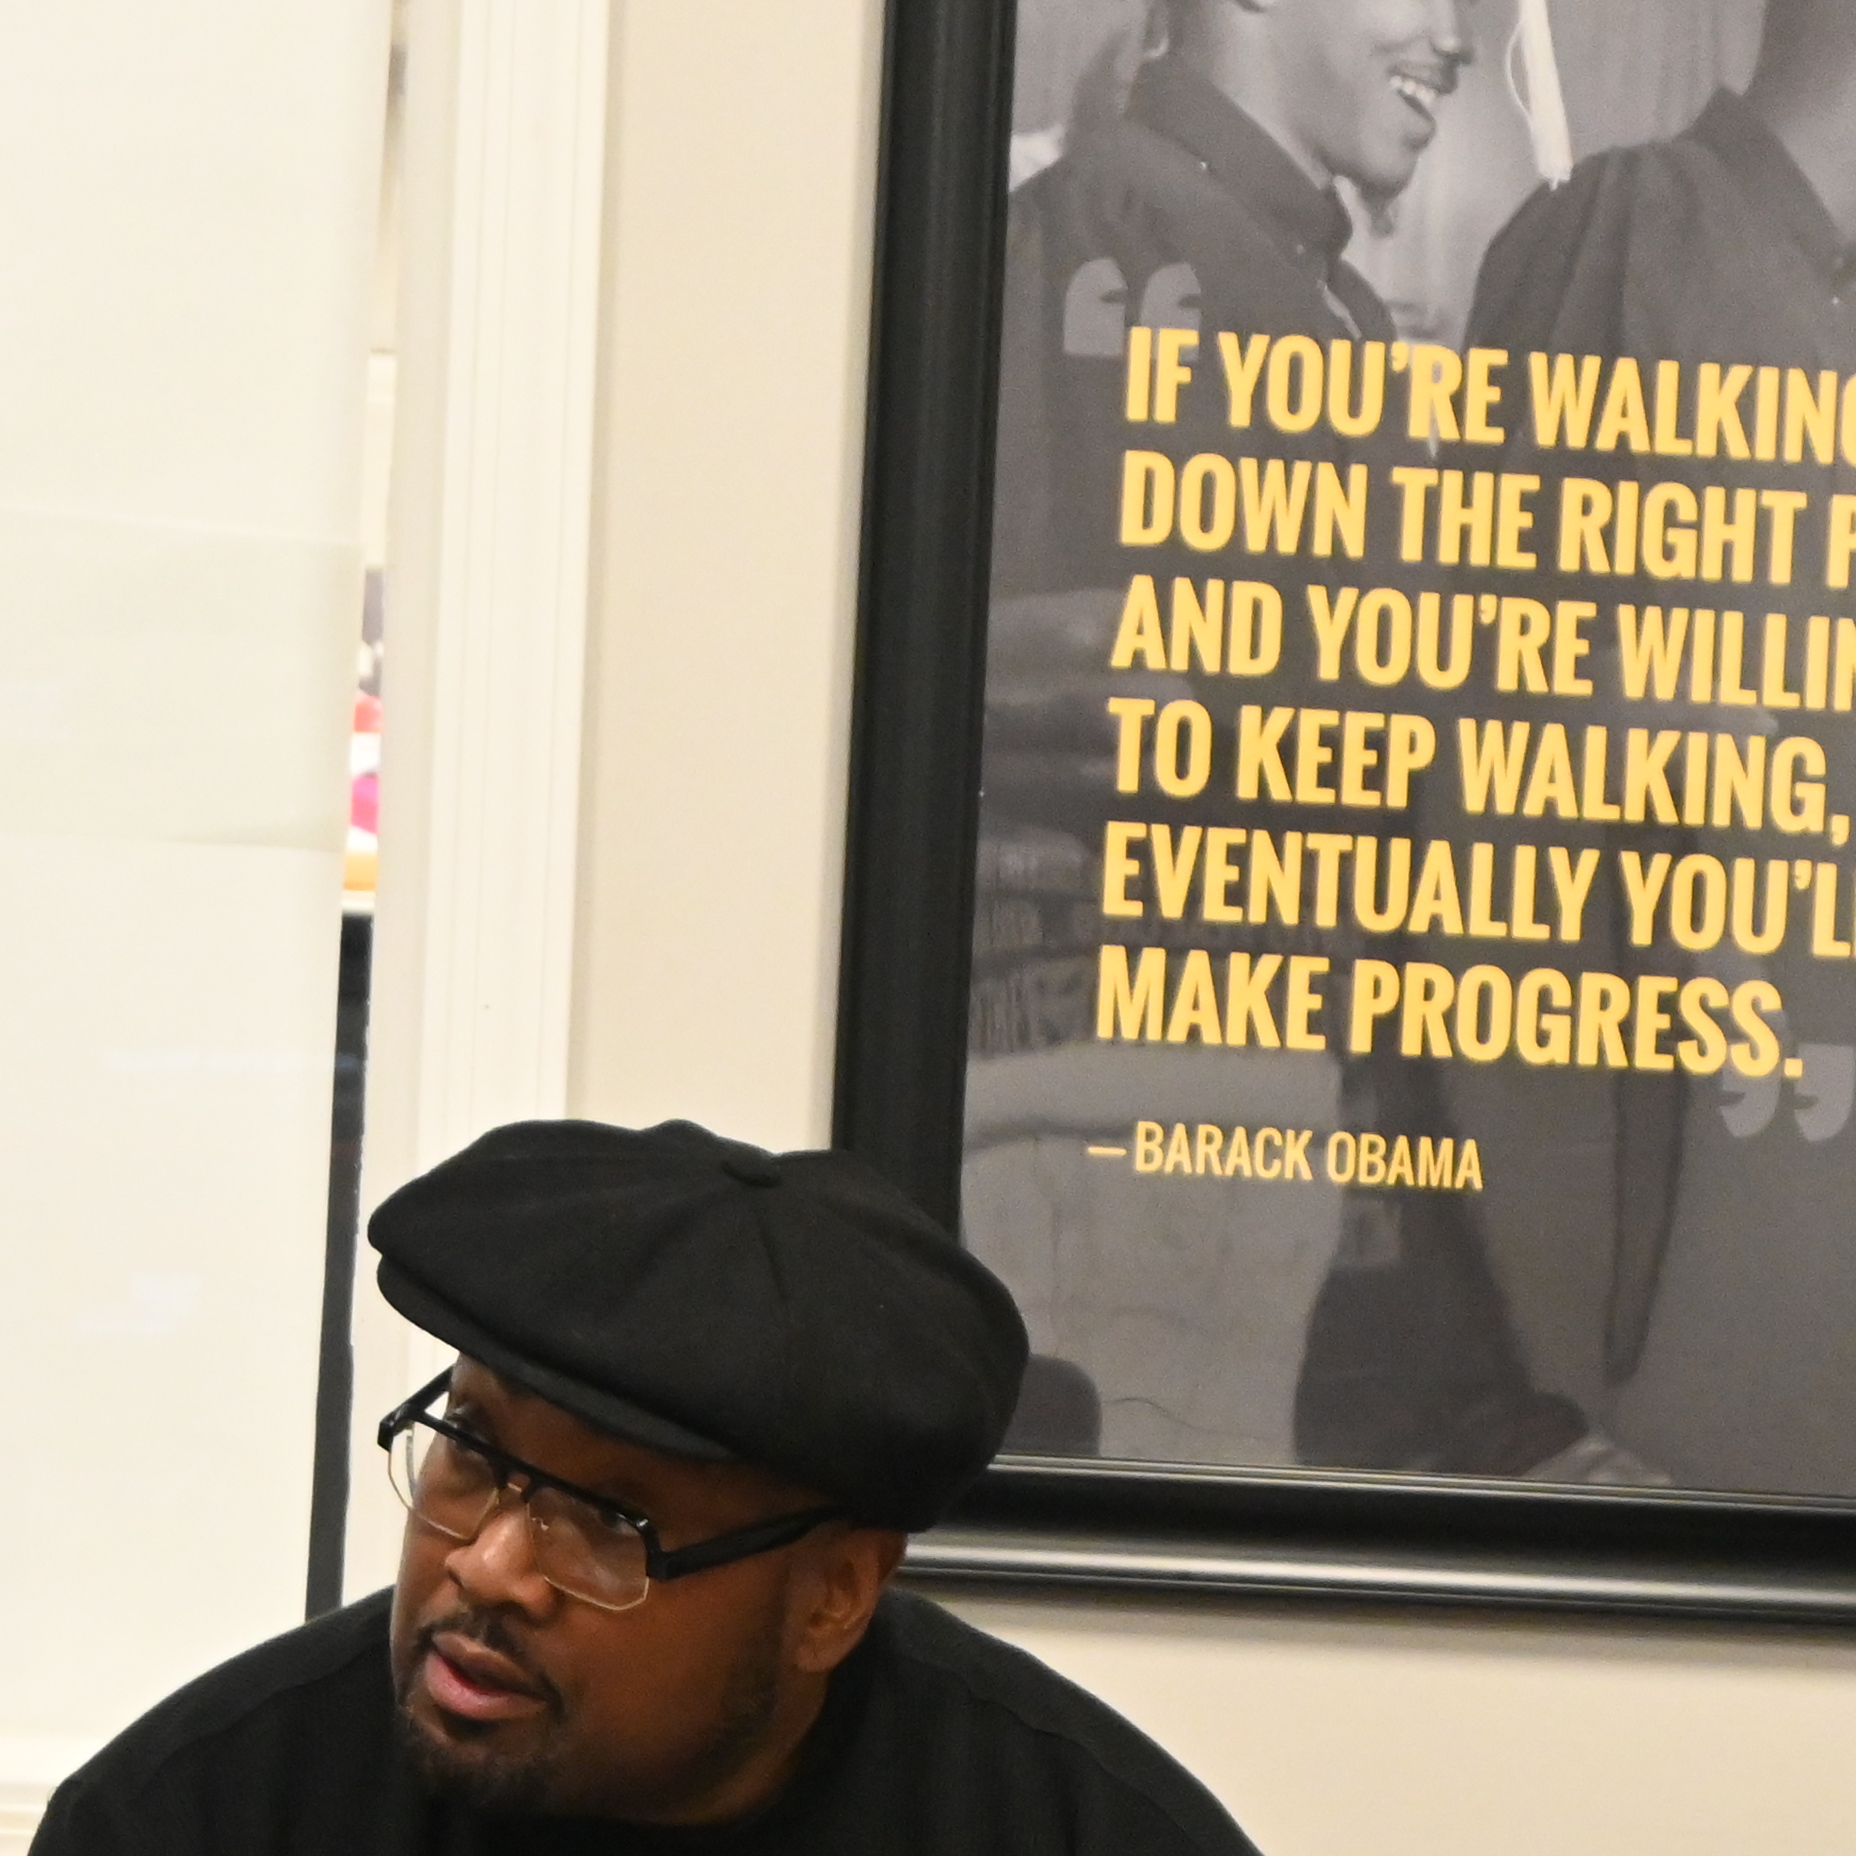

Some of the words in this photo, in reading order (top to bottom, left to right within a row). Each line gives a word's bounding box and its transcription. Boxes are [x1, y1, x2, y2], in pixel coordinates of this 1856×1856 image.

[1124, 325, 1201, 425] IF
[1216, 331, 1509, 446] YOU'RE
[1119, 449, 1369, 561] DOWN
[1388, 466, 1541, 571] THE
[1556, 476, 1809, 587] RIGHT
[1108, 573, 1284, 678] AND
[1305, 584, 1598, 698] YOU'RE
[1106, 696, 1213, 799] TO
[1235, 704, 1437, 810] KEEP
[1456, 717, 1851, 848] WALKING,
[1101, 820, 1601, 944] EVENTUALLY
[1095, 944, 1331, 1053] MAKE
[1348, 958, 1806, 1081] PROGRESS.
[1325, 1130, 1484, 1192] OBAMA
